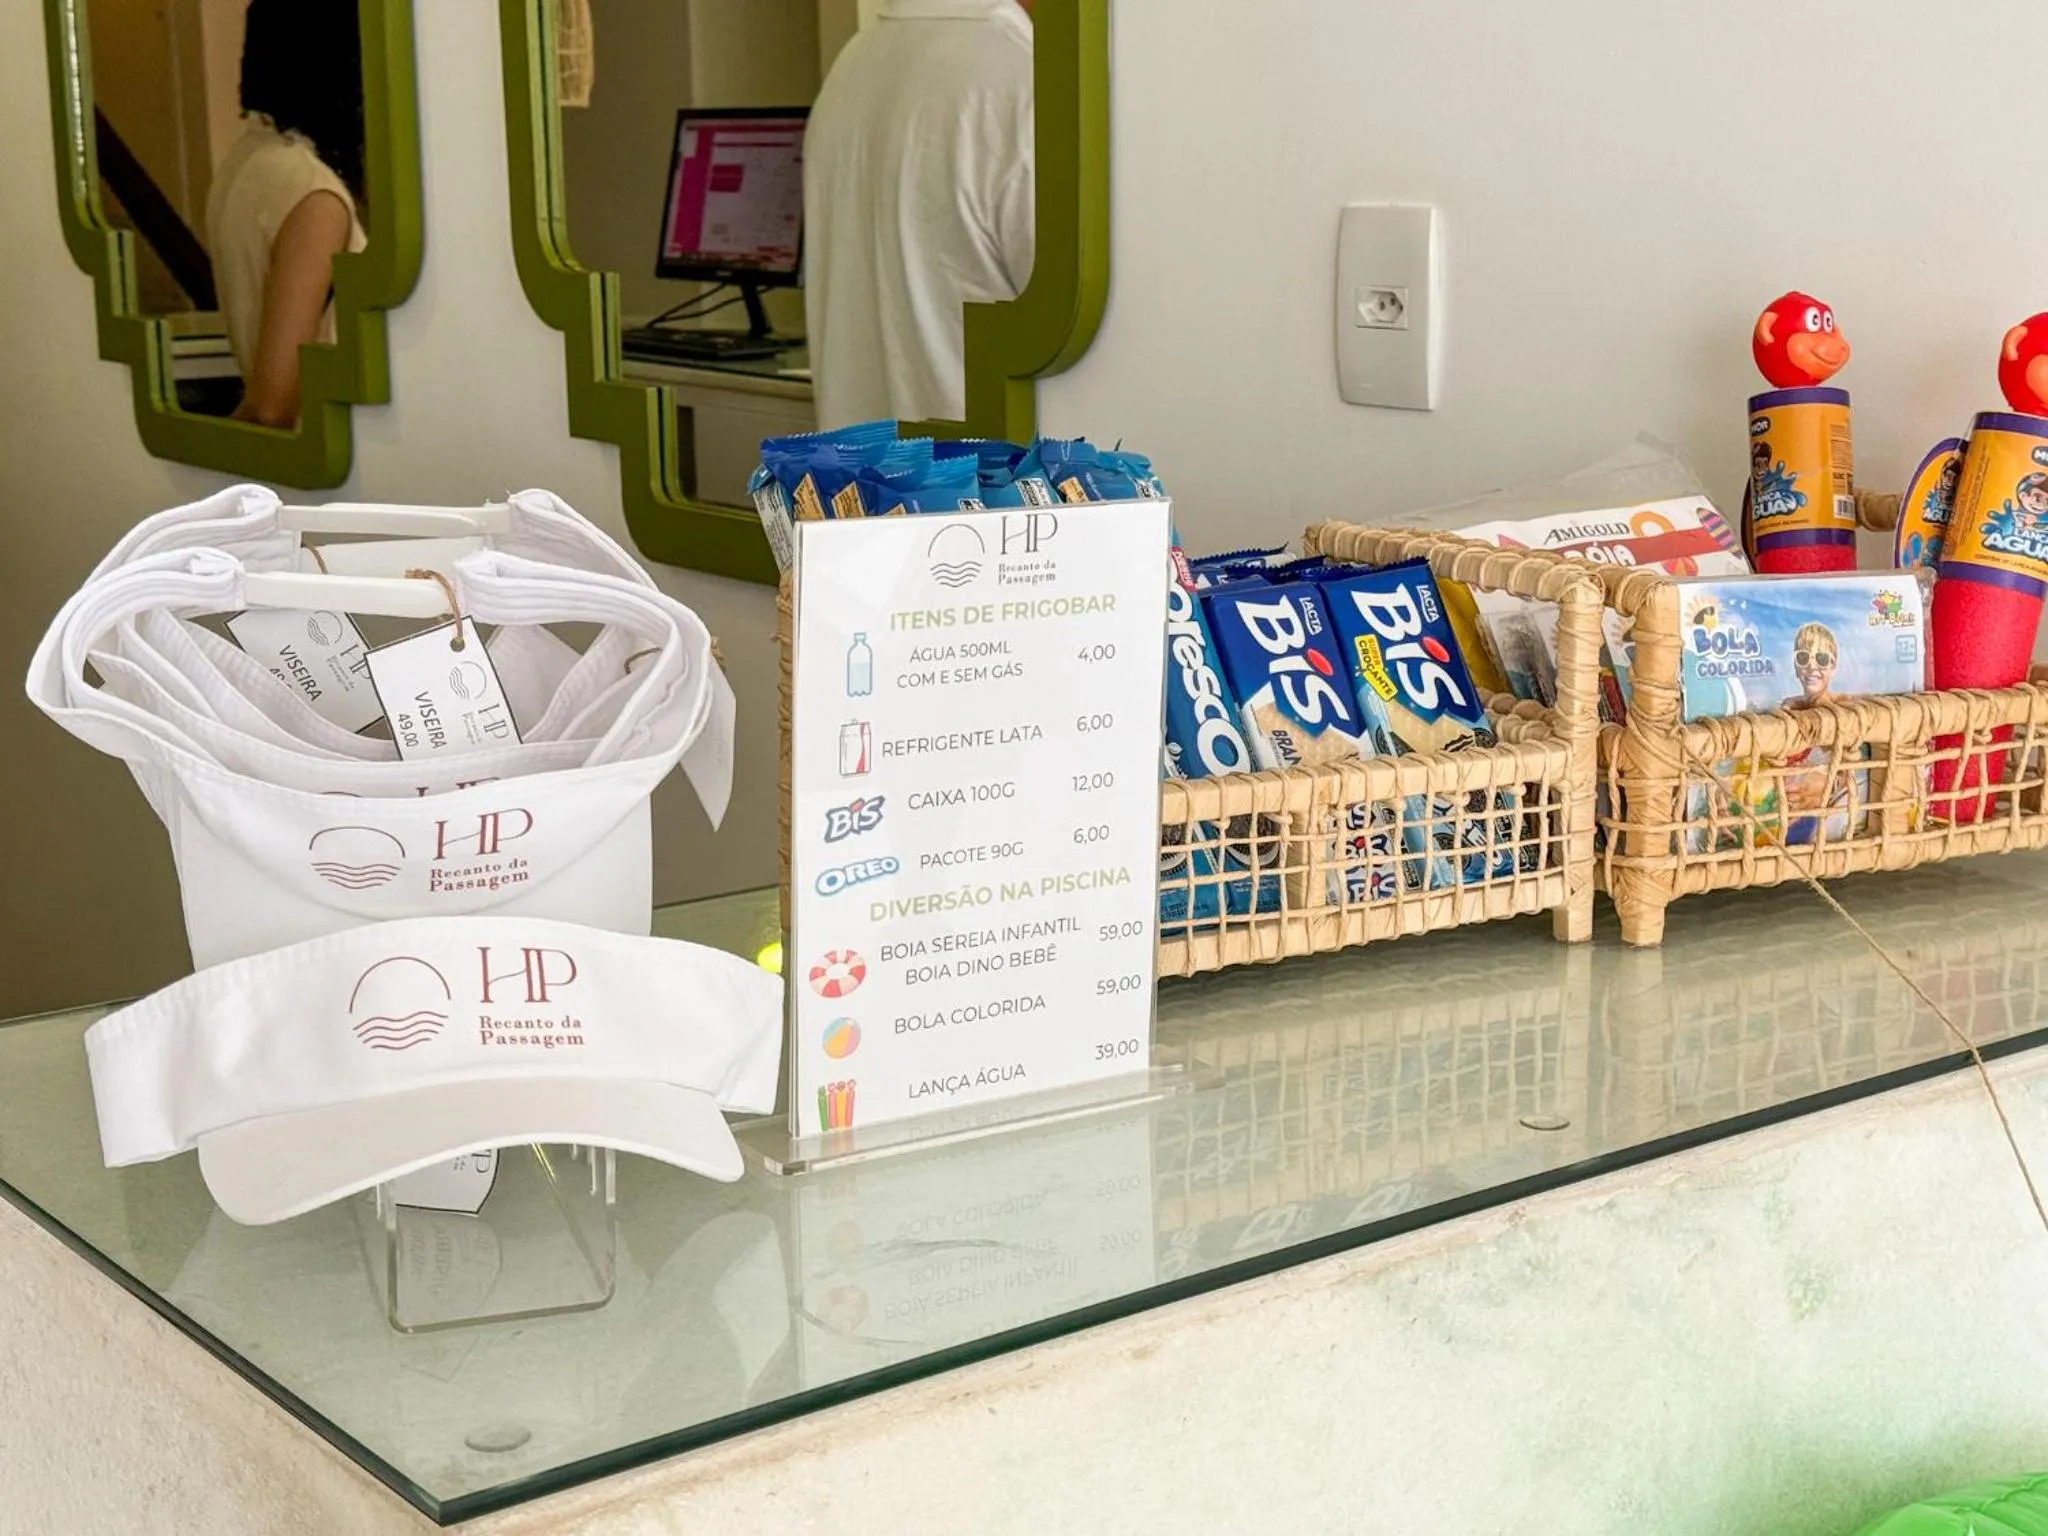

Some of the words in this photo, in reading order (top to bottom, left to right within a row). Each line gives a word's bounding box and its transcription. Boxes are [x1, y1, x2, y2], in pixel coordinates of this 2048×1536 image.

[999, 513, 1058, 555] HP
[999, 561, 1041, 573] Recanto
[1043, 560, 1057, 569] da
[1563, 541, 1637, 567] ÓIA
[999, 571, 1057, 585] Passagem
[890, 608, 956, 631] ITENS
[964, 605, 995, 624] DE
[1001, 594, 1116, 619] FRIGOBAR
[1300, 597, 1322, 636] LACTA
[1416, 584, 1439, 624] LACTA
[909, 646, 956, 663] ÁGUA
[960, 640, 1013, 658] 500ML
[1077, 644, 1116, 663] 4,00
[1693, 626, 1760, 657] BOLA
[279, 645, 323, 701] VISEIRA
[897, 672, 936, 689] COM
[940, 671, 951, 684] E
[954, 665, 988, 683] SEM
[991, 662, 1024, 680] GÁS
[1358, 639, 1394, 696] CROCANTE
[1697, 657, 1776, 679] COLORIDA
[398, 713, 420, 748] 49,00
[414, 691, 447, 749] VISEIRA
[882, 729, 995, 758] REFRIGENTE
[999, 724, 1043, 744] LATA
[1076, 713, 1114, 732] 6,00
[908, 789, 966, 810] CAIXA
[971, 781, 1015, 802] 100G
[1072, 772, 1114, 792] 12,00
[433, 807, 534, 861] HP
[430, 863, 501, 880] Recanto
[504, 858, 528, 870] da
[815, 856, 900, 897] OREO
[920, 846, 987, 869] PACOTE
[991, 842, 1024, 860] 90G
[1073, 825, 1110, 844] 6,00
[429, 872, 529, 893] Passagem
[870, 886, 993, 922] DIVERSÃO
[1000, 878, 1033, 902] NA
[1041, 866, 1131, 894] PISCINA
[881, 942, 927, 962] BOIA
[932, 930, 997, 953] SEREIA
[1002, 917, 1081, 942] INFANTIL
[1099, 920, 1143, 942] 59,00
[476, 946, 578, 1003] HP
[905, 964, 952, 985] BOIA
[957, 955, 1005, 977] DINO
[1009, 943, 1058, 968] BEBÊ
[1096, 975, 1141, 996] 59,00
[479, 1015, 555, 1030] Recanto
[561, 1014, 582, 1029] da
[895, 1014, 945, 1034] BOLA
[950, 995, 1046, 1025] COLORIDA
[480, 1031, 585, 1049] Passagem
[1094, 1038, 1139, 1061] 39,00
[909, 1073, 971, 1099] LANÇA
[975, 1063, 1026, 1086] ÁGUA
